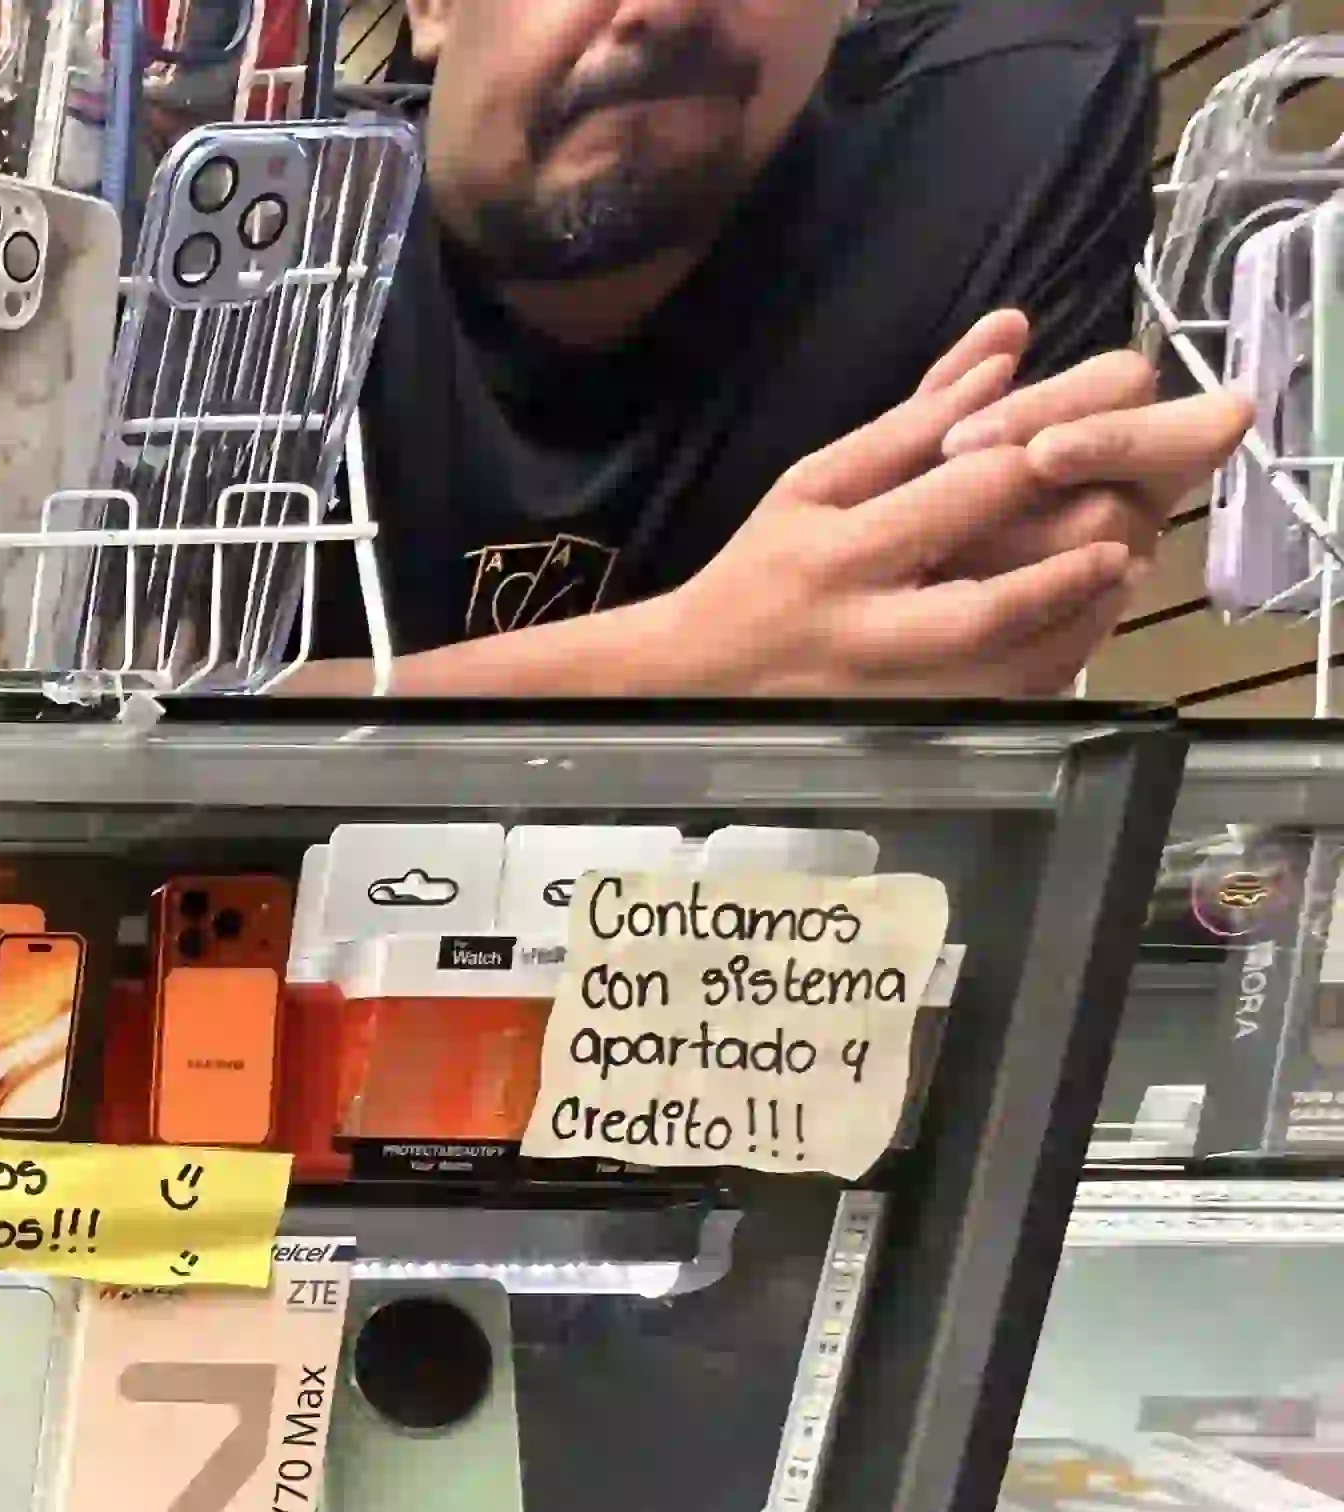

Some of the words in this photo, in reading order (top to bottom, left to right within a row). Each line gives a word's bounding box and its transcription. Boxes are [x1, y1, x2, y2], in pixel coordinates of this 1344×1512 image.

[589, 876, 861, 944] Contamos
[452, 950, 503, 966] Watch
[581, 963, 669, 1011] con
[702, 955, 907, 1006] sistema
[570, 1019, 818, 1080] apartado
[840, 1038, 870, 1081] y
[550, 1097, 806, 1163] Credito!!!
[286, 1279, 340, 1305] ZTE
[281, 1364, 327, 1446] Max
